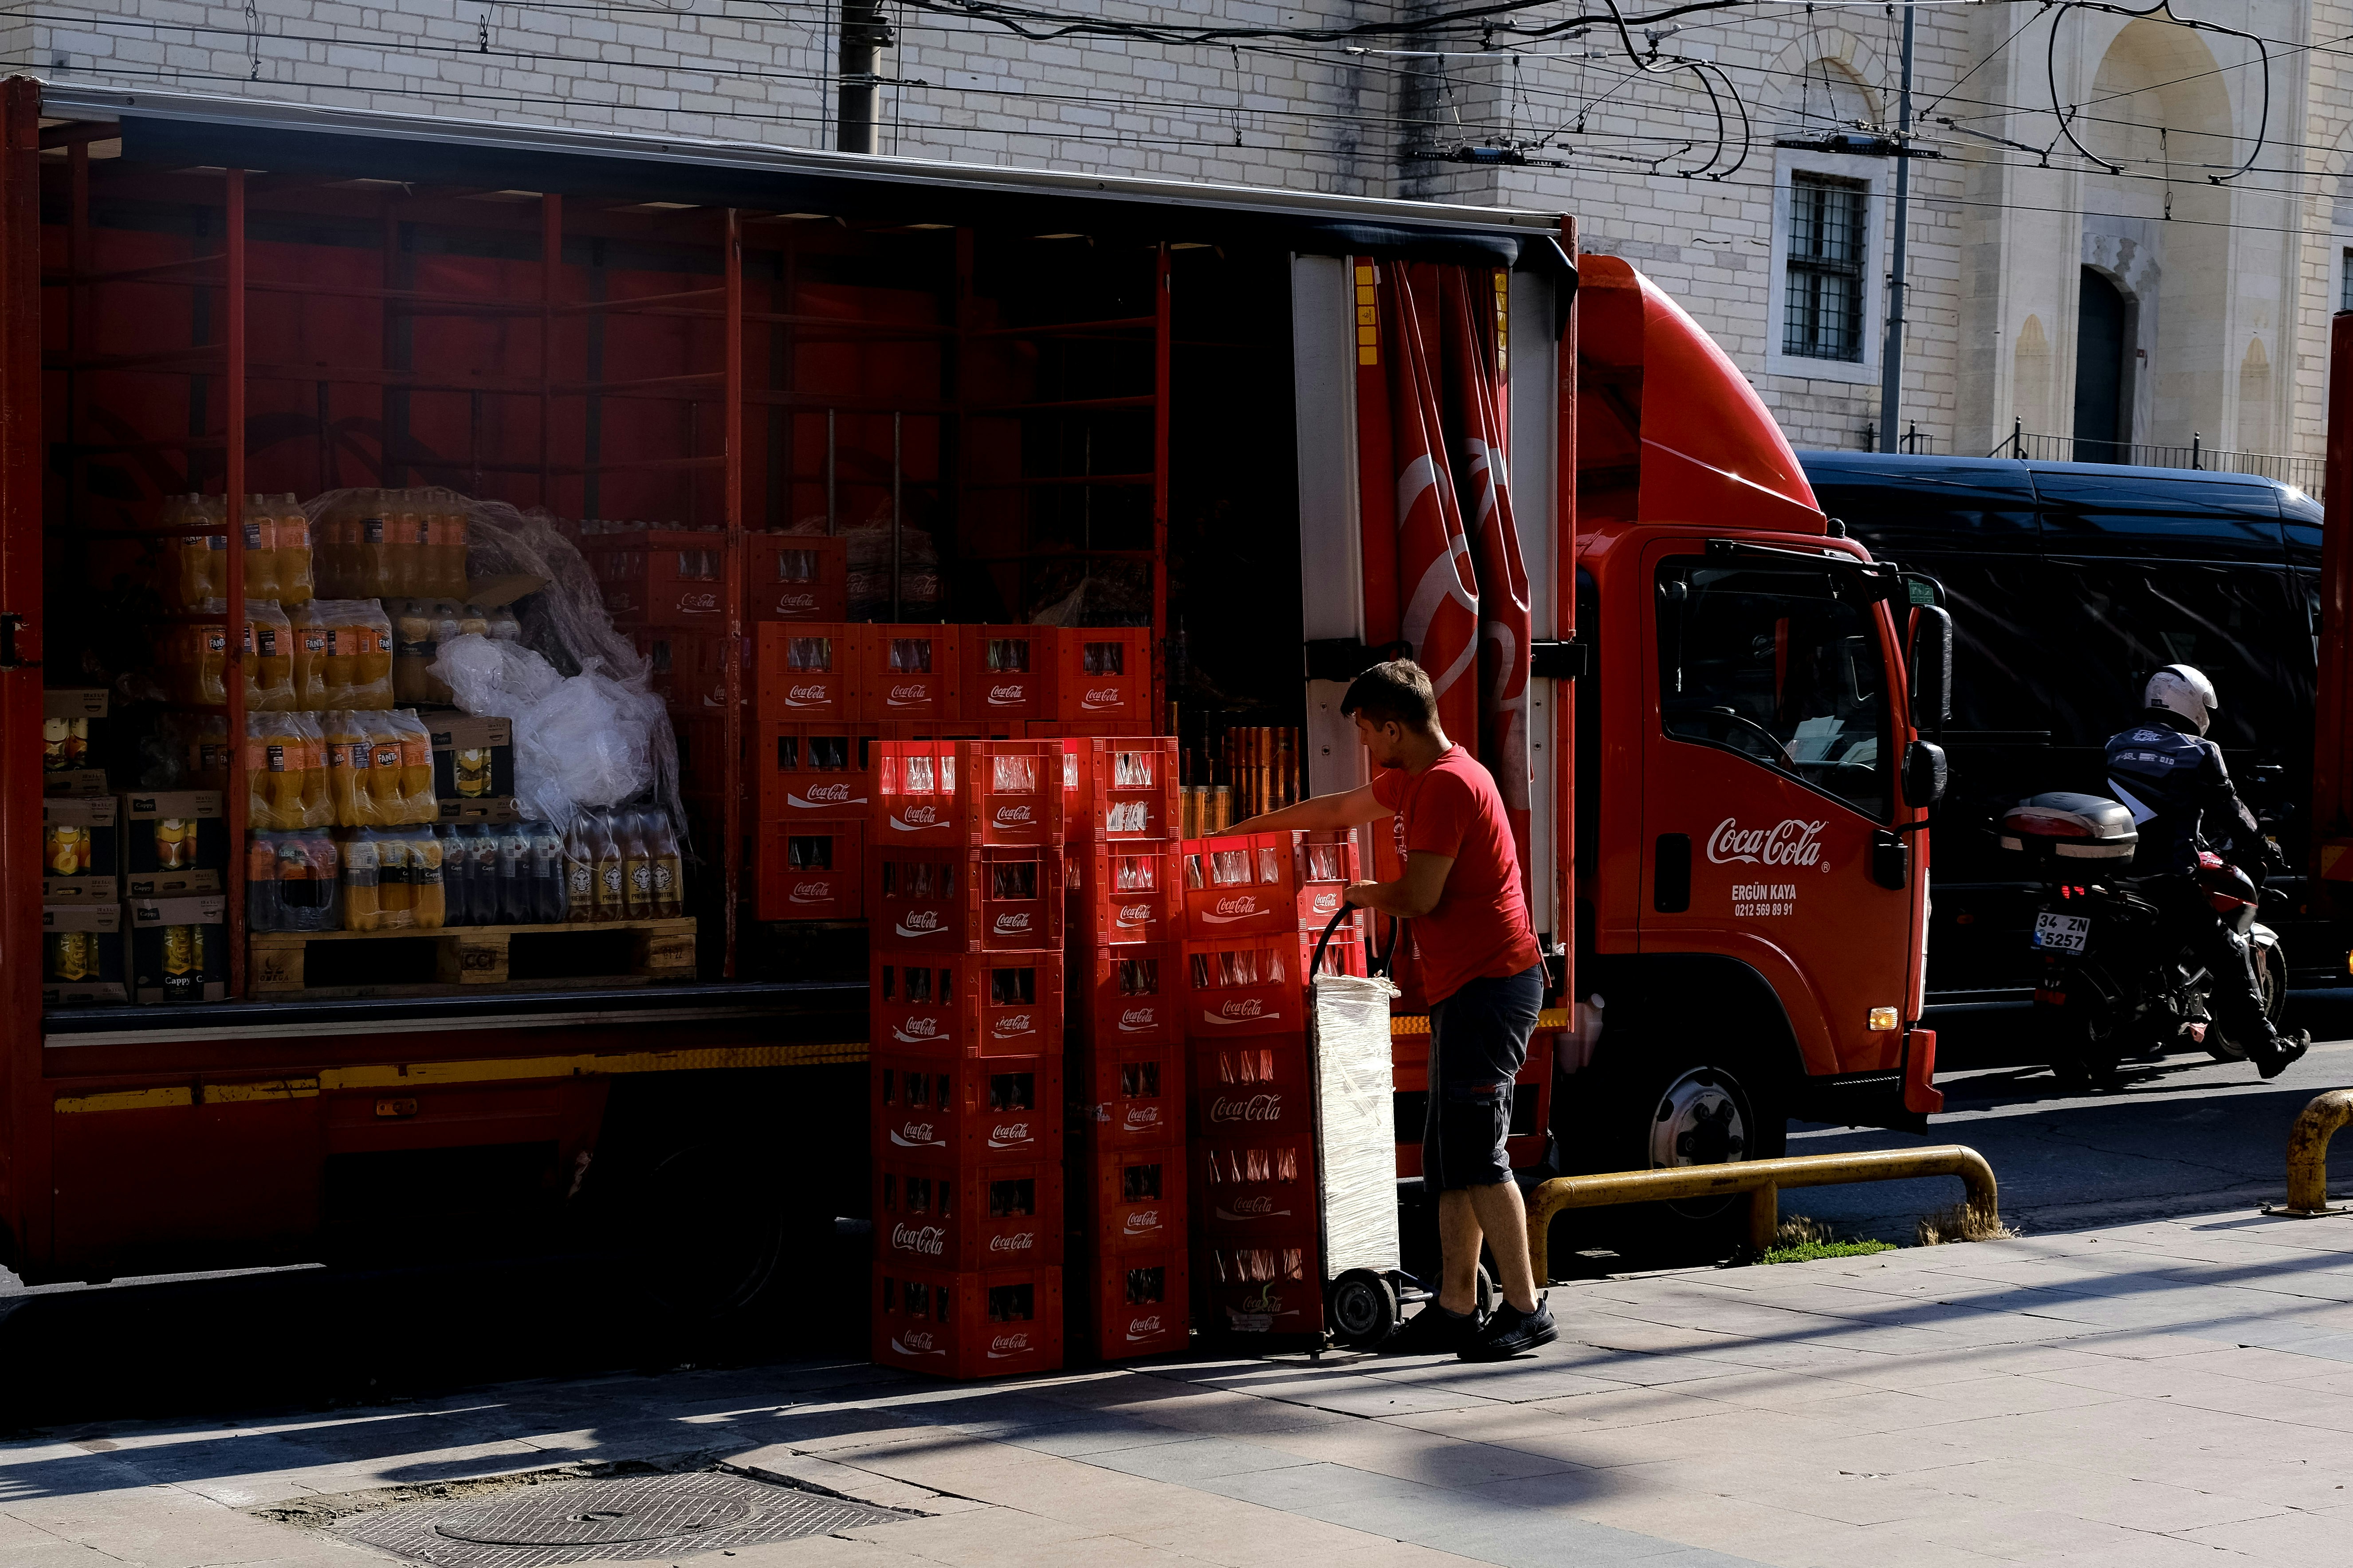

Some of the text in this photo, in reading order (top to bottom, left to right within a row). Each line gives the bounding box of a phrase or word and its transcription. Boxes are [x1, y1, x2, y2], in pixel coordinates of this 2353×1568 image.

[780, 594, 813, 606] Coca-Cola
[379, 638, 390, 648] FAN
[790, 685, 826, 699] Coca-Cola
[891, 685, 926, 698] Coca-Cola
[990, 686, 1023, 698] Coca-Cola
[1085, 688, 1119, 701] Coca-Cola
[807, 784, 850, 801] Coca-Cola
[904, 805, 937, 823] Coca-Cola
[997, 806, 1032, 821] Coca-Cola
[1707, 817, 1827, 866] Coca-Cola
[794, 882, 830, 896] Coca-Cola
[1732, 881, 1796, 901] ERGÜN KAYA
[1216, 896, 1257, 914] Coca-Cola
[1314, 893, 1337, 907] Coca-Cola
[1120, 905, 1151, 919] Coca-Cola
[1735, 903, 1793, 916] 0212 569 89 91
[907, 910, 939, 929] Coca-Cola
[996, 913, 1030, 928] Coca-Cola
[2039, 914, 2087, 932] 34 ZN
[2045, 932, 2084, 948] 5257
[165, 976, 191, 986] Cappy
[1122, 1008, 1154, 1023] Coca-Cola
[1222, 999, 1262, 1016] Coca-Cola
[906, 1016, 938, 1036] Coca-Cola
[1127, 1107, 1159, 1122] Coca-Cola
[1210, 1094, 1282, 1123] Coca-Cola
[903, 1121, 935, 1141] Coca-Cola
[993, 1123, 1029, 1139] Coca-Cola
[1233, 1196, 1273, 1213] Coca-Cola
[1127, 1210, 1159, 1227] Coca-Cola
[892, 1222, 946, 1255] Coca-Cola
[990, 1232, 1034, 1252] Coca-Cola
[1130, 1315, 1160, 1333] Coca-Cola
[904, 1329, 934, 1350] Coca-Cola
[992, 1333, 1029, 1350] Coca-Cola
